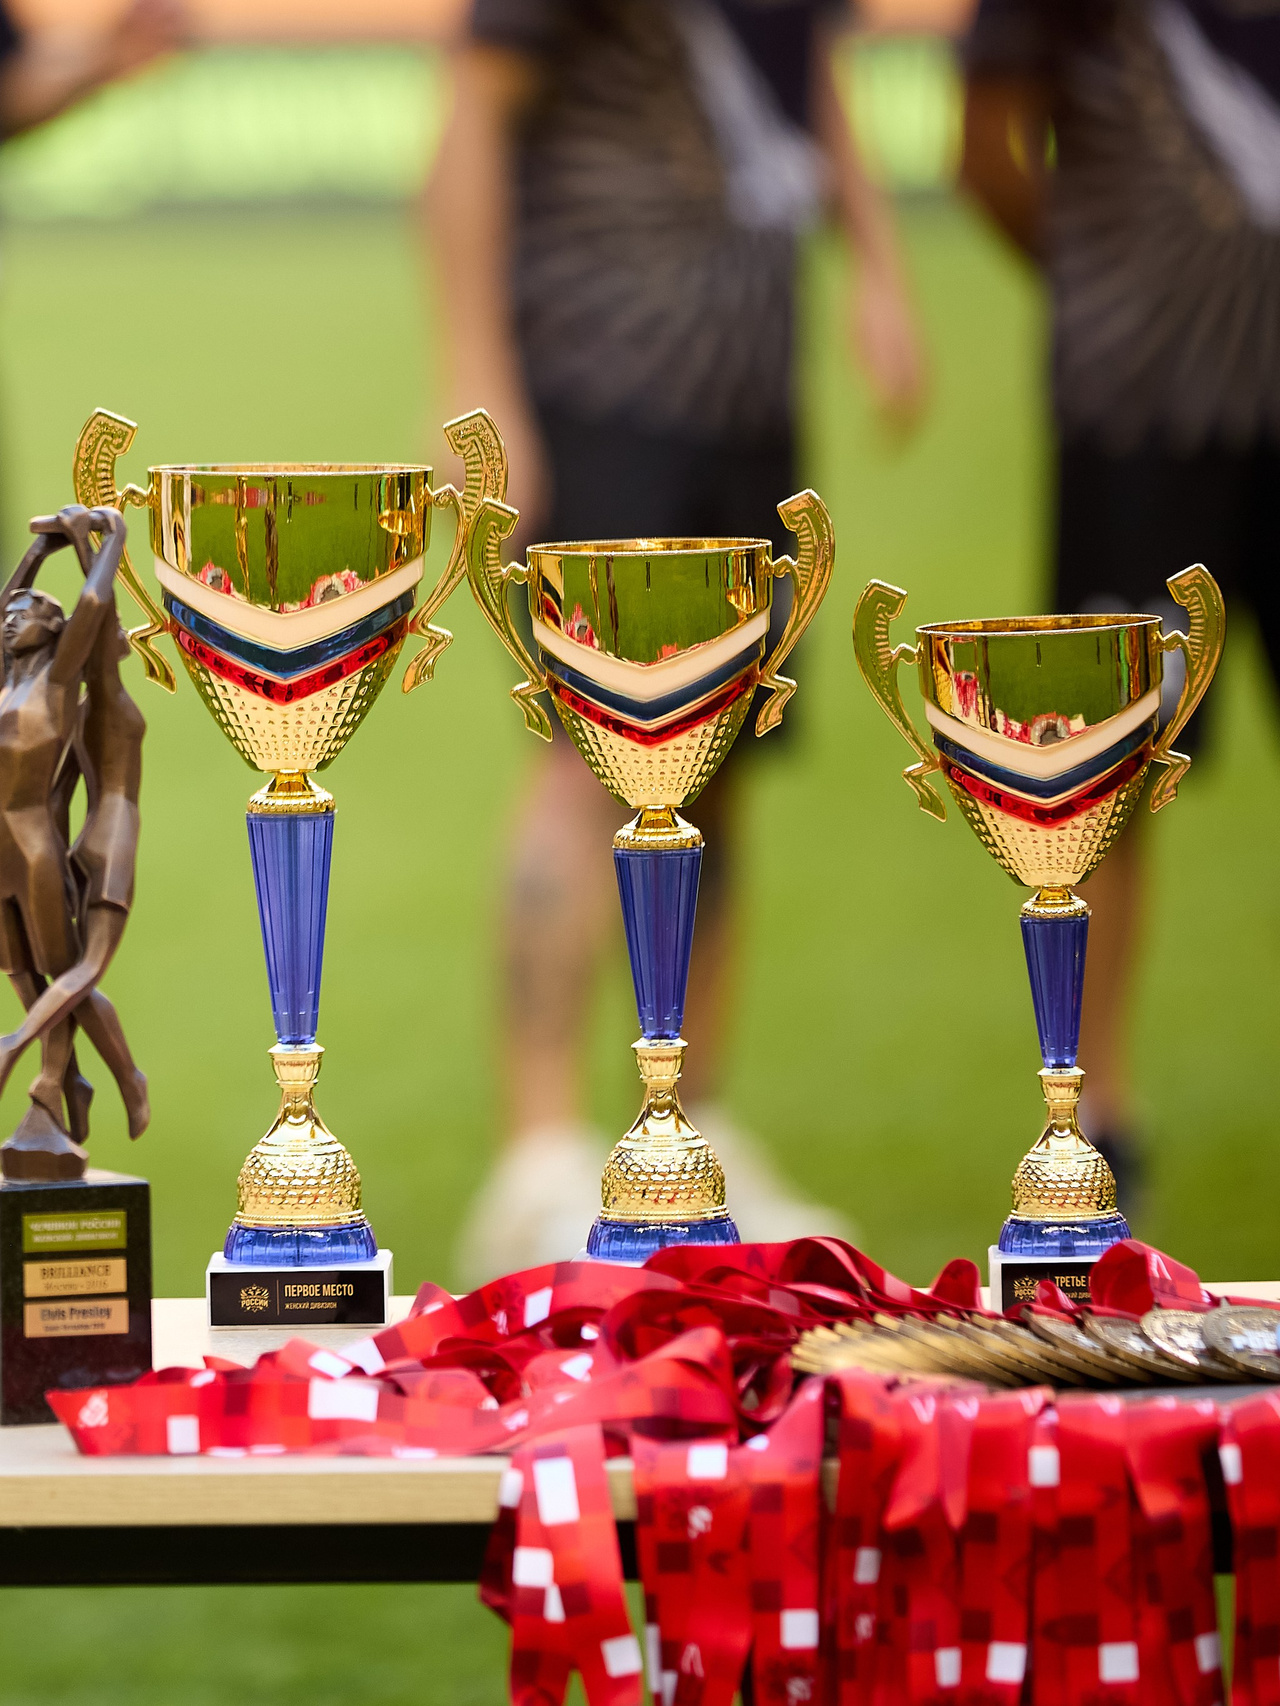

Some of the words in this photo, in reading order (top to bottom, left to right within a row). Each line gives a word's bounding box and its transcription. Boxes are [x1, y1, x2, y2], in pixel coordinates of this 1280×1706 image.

[41, 1265, 111, 1279] BRILLIANCE
[1054, 1275, 1086, 1287] ТРЕТЬЕ
[284, 1284, 321, 1297] ПЕРВОЕ
[322, 1283, 354, 1296] МЕСТО
[241, 1298, 269, 1308] РОССИИ
[284, 1302, 310, 1310] ЖЕНСКИЙ
[310, 1302, 338, 1310] ДИВИЗИОН
[41, 1308, 66, 1320] Elvis
[69, 1307, 111, 1320] Presley
